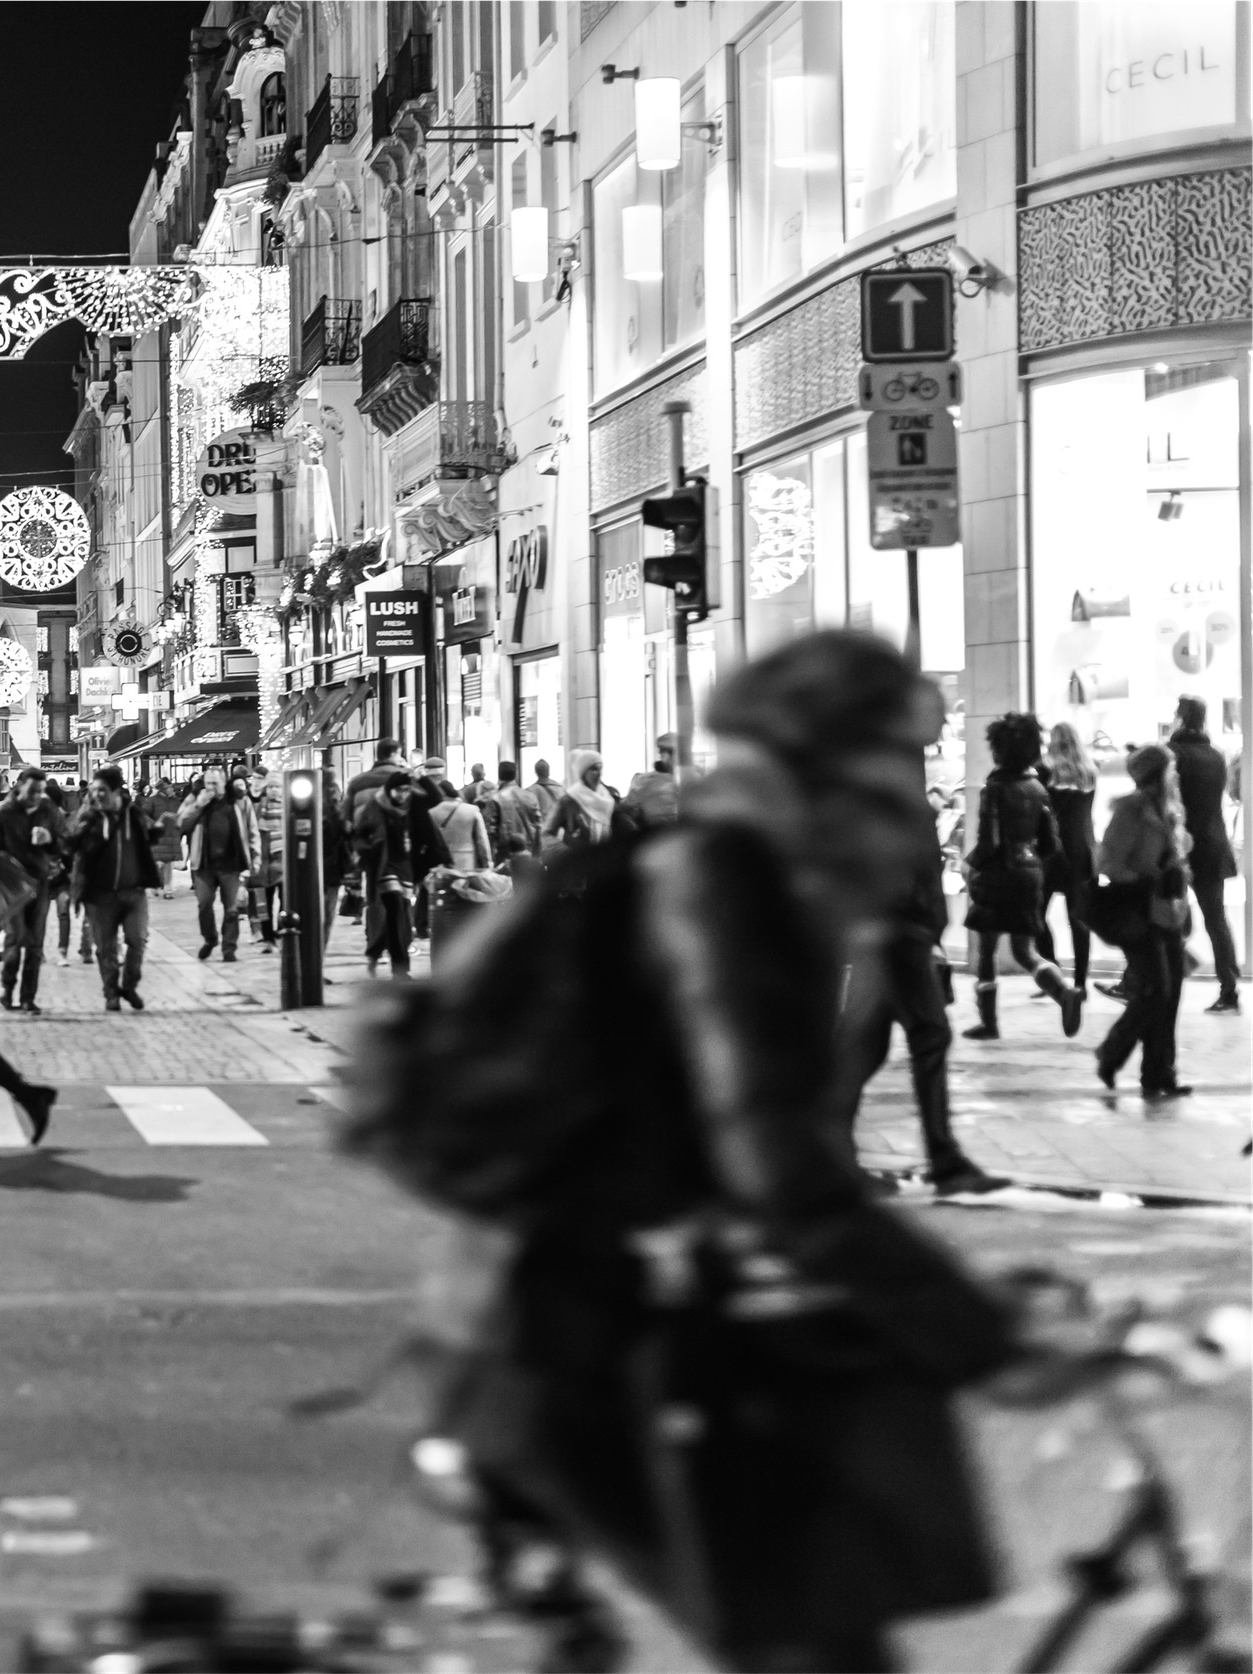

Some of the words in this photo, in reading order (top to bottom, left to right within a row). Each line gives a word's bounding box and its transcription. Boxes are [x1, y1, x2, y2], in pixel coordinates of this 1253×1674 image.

[1106, 45, 1220, 94] CECIL
[890, 414, 933, 430] ZONE
[207, 442, 257, 467] DRU
[201, 469, 257, 497] OPE
[505, 524, 548, 644] SAXO
[1169, 580, 1225, 594] CECIL
[369, 601, 419, 616] LUSH
[107, 621, 149, 640] PASSAGE
[376, 629, 413, 637] HANDMADE
[375, 639, 414, 647] COSMETICS
